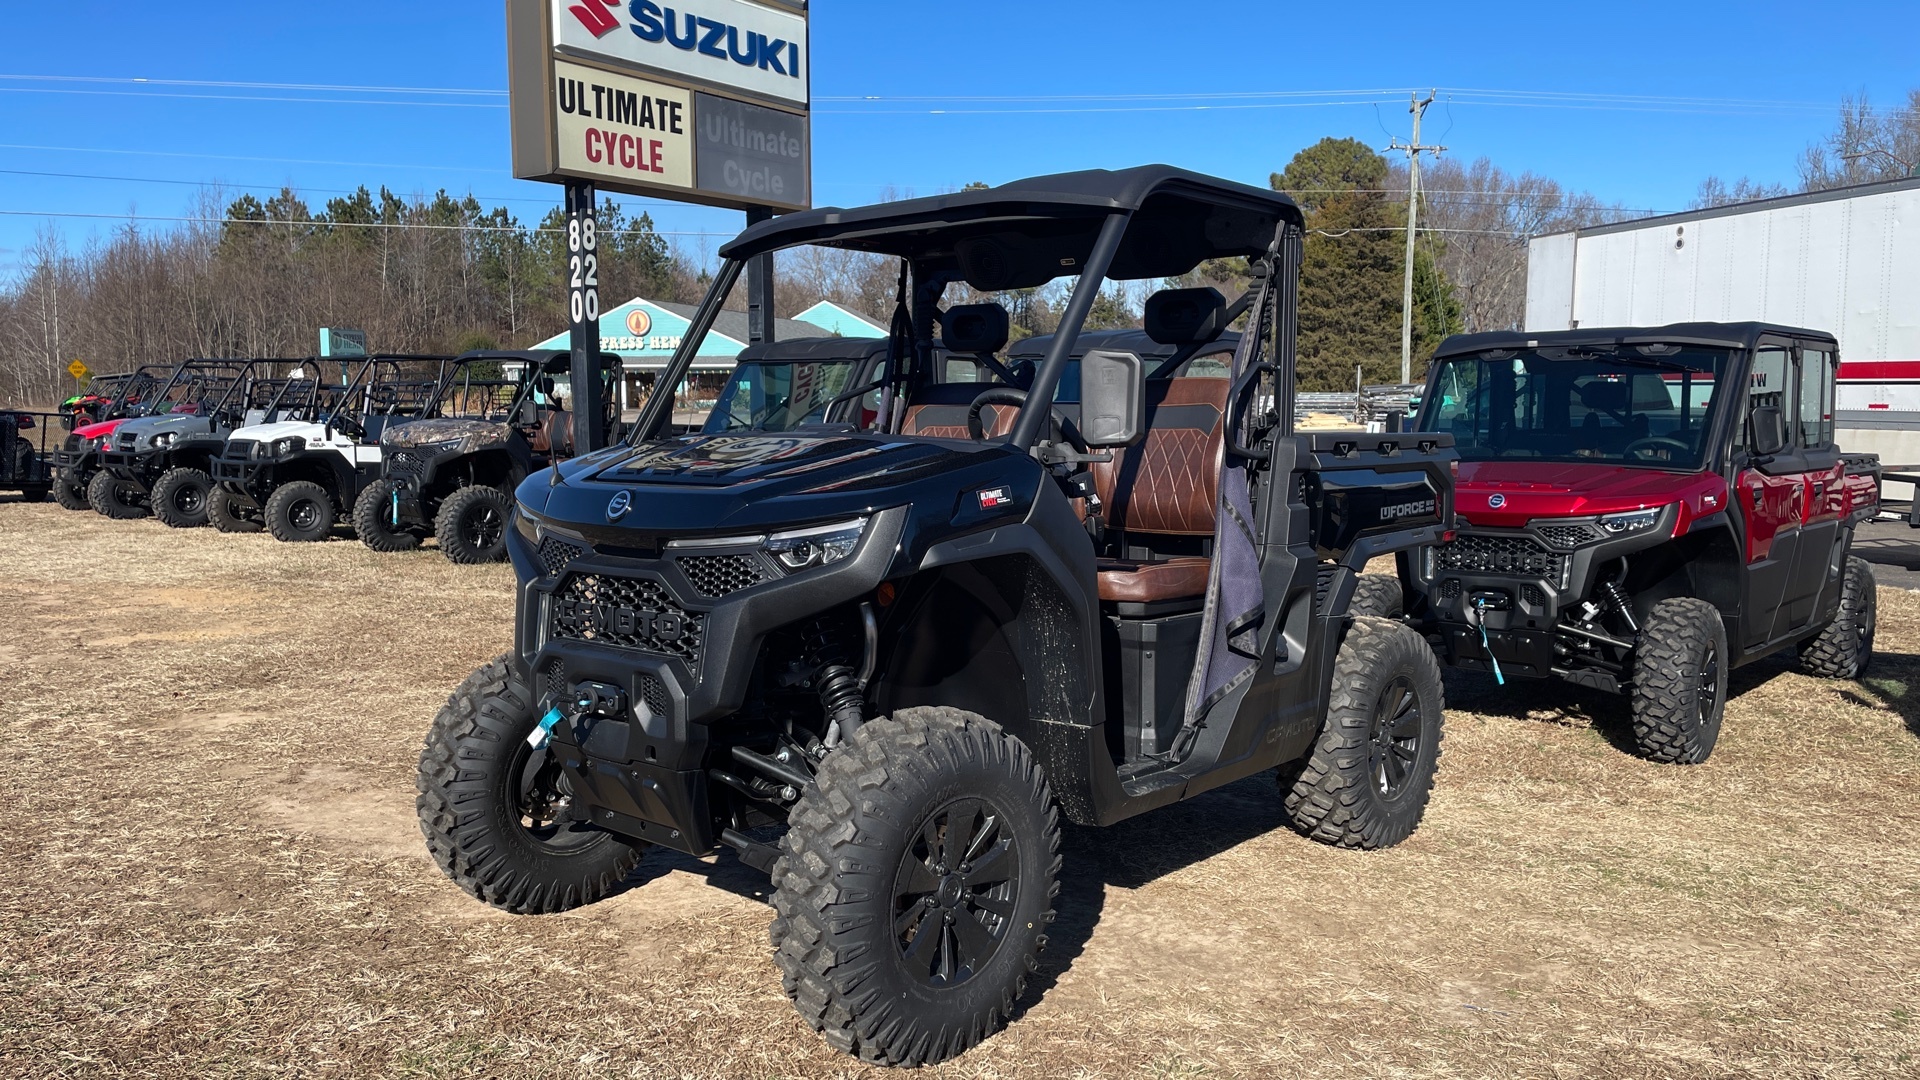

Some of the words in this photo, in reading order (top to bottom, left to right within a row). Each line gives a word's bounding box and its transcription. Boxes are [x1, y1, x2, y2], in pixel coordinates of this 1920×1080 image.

[629, 0, 799, 78] SUZUKI
[558, 77, 683, 135] ULTIMATE
[585, 127, 664, 174] CYCLE
[705, 113, 800, 158] Ultimate
[723, 160, 784, 197] Cycle
[600, 336, 645, 350] PRESS
[650, 336, 681, 350] HEM
[980, 489, 1002, 500] ULTIMATE
[982, 498, 997, 507] CYCLE
[1380, 501, 1425, 520] UFORCE
[1446, 550, 1546, 568] CFMOTO
[559, 600, 681, 641] CFMOTO
